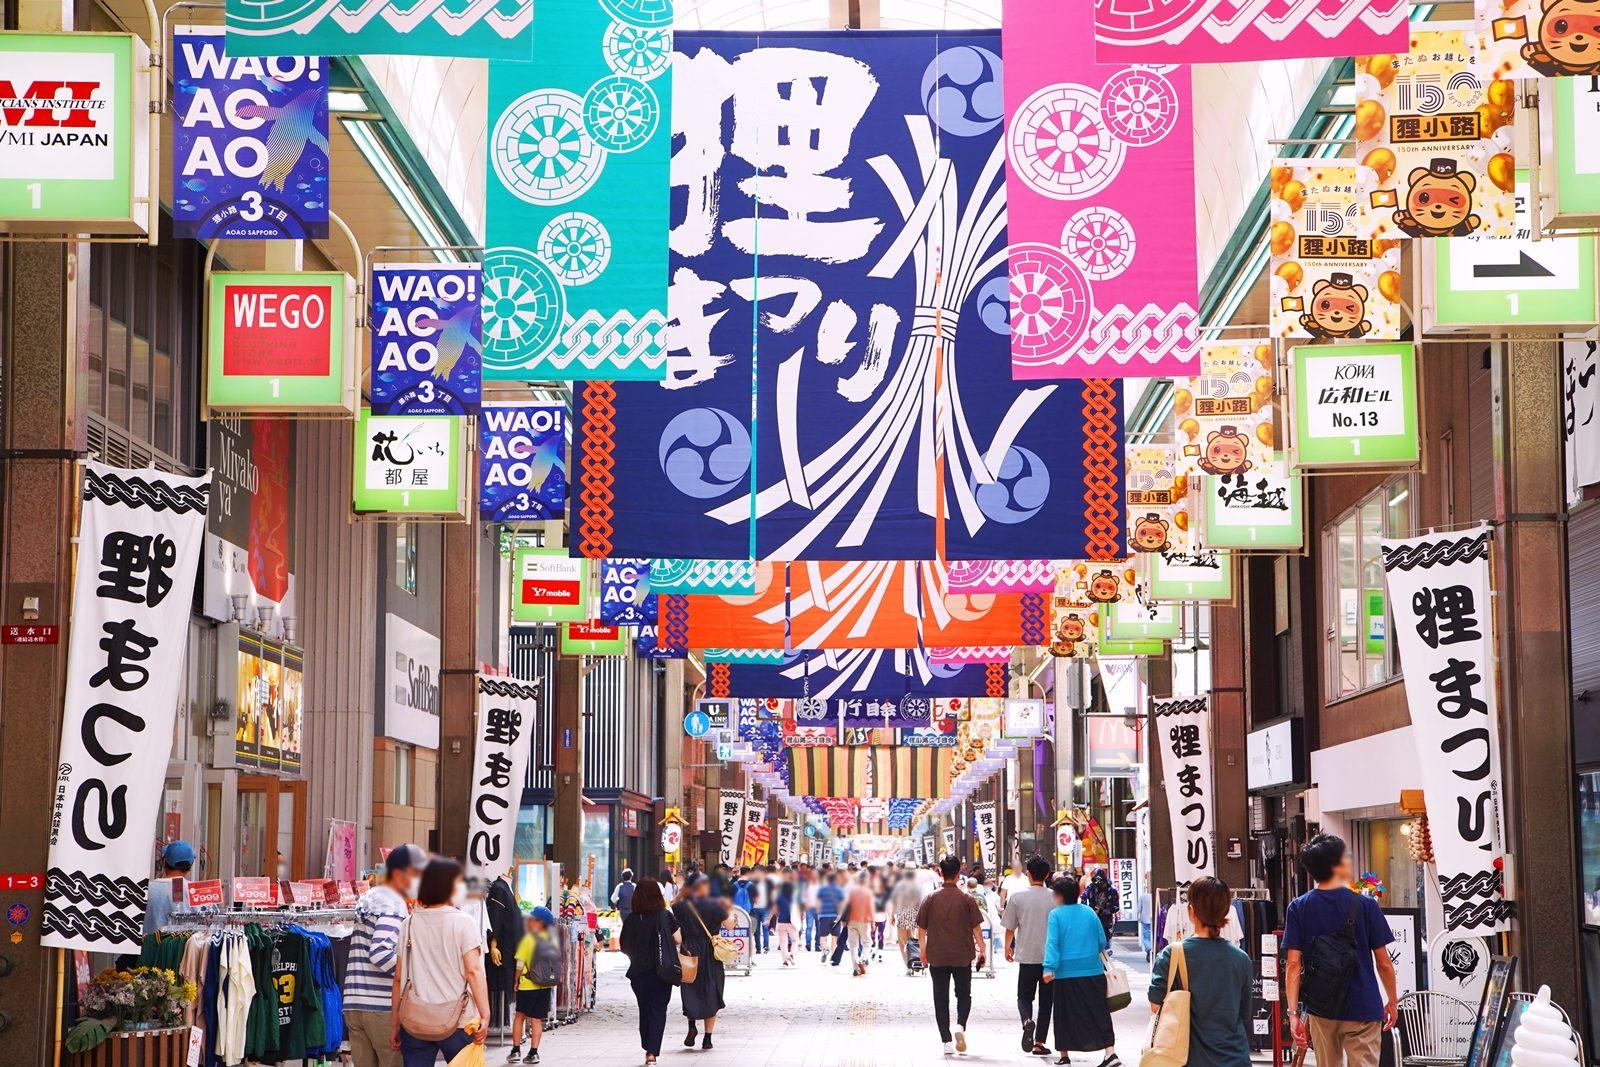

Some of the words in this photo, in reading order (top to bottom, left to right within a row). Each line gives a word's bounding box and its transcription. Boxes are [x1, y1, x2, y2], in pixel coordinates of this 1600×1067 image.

[182, 43, 321, 81] WAO!
[0, 99, 38, 109] CIANS
[42, 99, 106, 110] INSTITUTE
[1396, 116, 1475, 139] 狸小路
[40, 132, 108, 147] JAPAN
[1421, 144, 1475, 152] ANNIVERSARY
[182, 136, 269, 178] AO
[27, 182, 42, 209] 1
[240, 191, 264, 221] 3
[1304, 238, 1368, 256] 狸小路
[378, 274, 476, 302] WAO!
[233, 293, 325, 329] WEGO
[1506, 293, 1518, 315] 1
[377, 341, 439, 372] AO
[269, 378, 280, 398] 1
[417, 380, 435, 404] 3
[1318, 386, 1393, 405] 広和ビル
[1200, 400, 1247, 413] 狸小路
[485, 410, 561, 432] WAO!
[1332, 411, 1379, 428] No.13
[1350, 438, 1361, 456] 1
[219, 431, 259, 495] Miyako
[485, 463, 533, 487] AO
[219, 480, 231, 523] ya
[401, 491, 410, 507] 1
[1248, 527, 1257, 541] 1
[540, 563, 577, 573] SoftBank
[603, 586, 637, 603] AO
[1186, 582, 1193, 594] 1
[547, 605, 553, 617] 1
[10, 627, 51, 636] 送水口
[1169, 725, 1209, 870] 狸まつり
[192, 893, 220, 903] ¥999
[239, 890, 267, 898] ¥999
